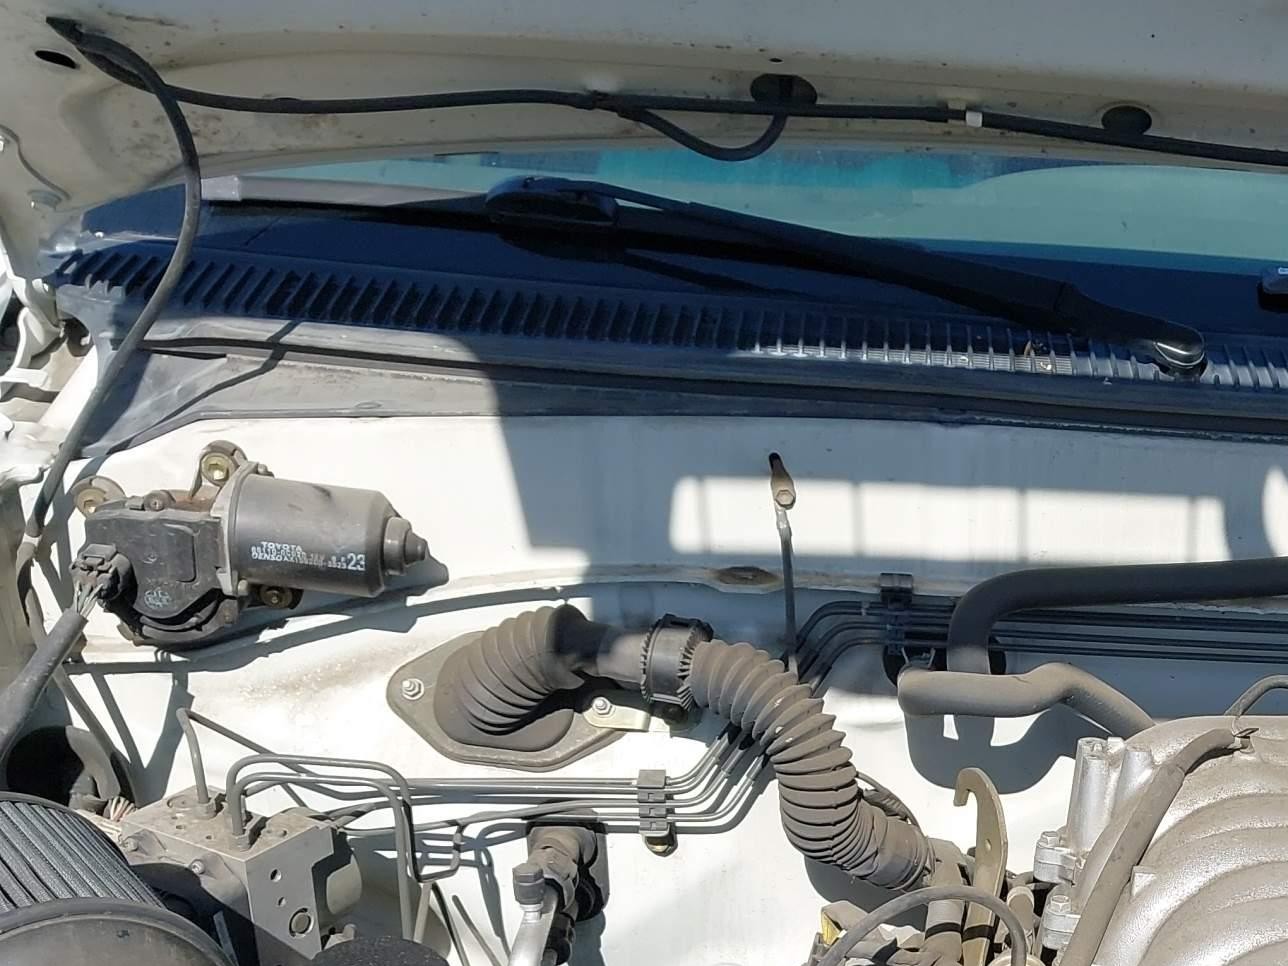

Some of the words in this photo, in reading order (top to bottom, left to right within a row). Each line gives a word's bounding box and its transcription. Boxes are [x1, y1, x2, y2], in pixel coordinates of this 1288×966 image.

[260, 541, 303, 553] TOYOTA
[251, 552, 283, 562] DENSO
[347, 552, 367, 572] 23
